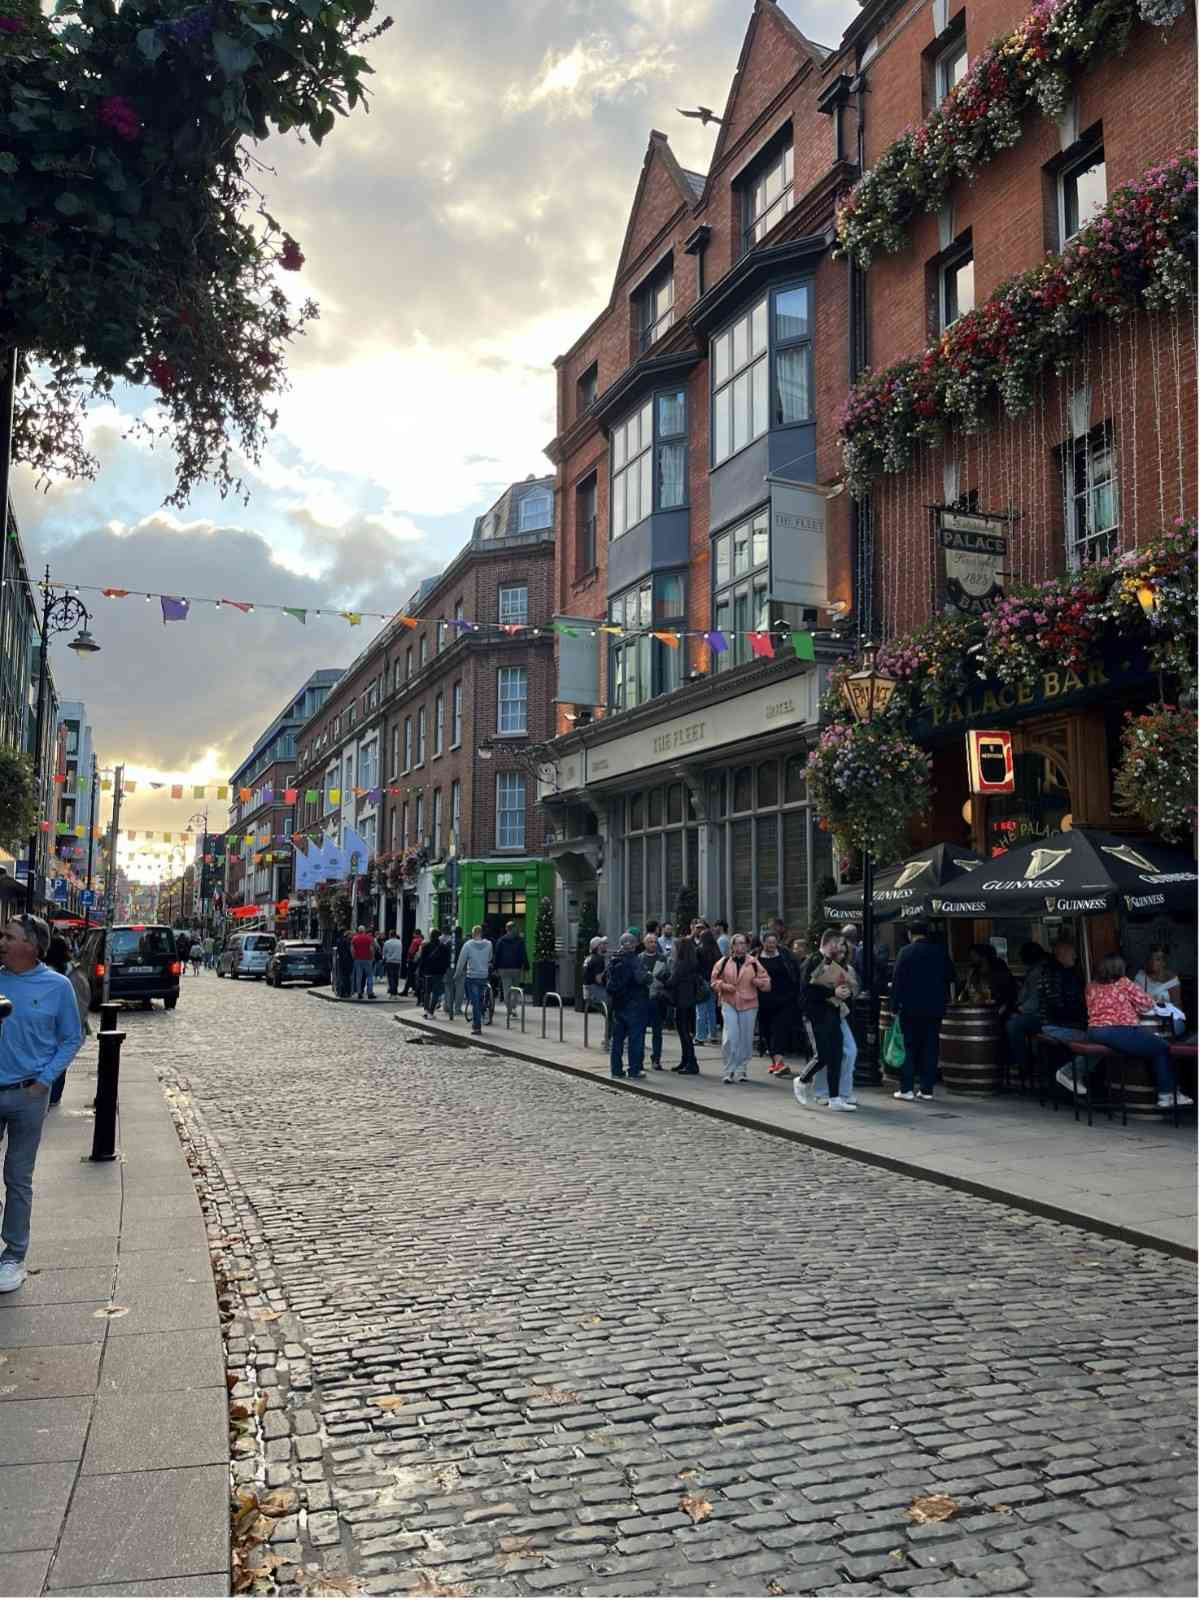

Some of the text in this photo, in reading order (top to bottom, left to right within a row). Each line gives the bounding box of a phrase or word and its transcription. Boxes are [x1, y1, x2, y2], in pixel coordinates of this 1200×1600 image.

[943, 530, 1006, 552] PALACE
[959, 594, 993, 612] BAR
[931, 664, 1110, 727] PALACE BAR
[653, 722, 705, 753] THE FLEET
[54, 879, 62, 889] P
[981, 878, 1065, 891] GUINNESS
[941, 901, 987, 912] GUINNESS
[1056, 898, 1107, 911] GUINNESS
[1131, 893, 1166, 908] GUINNESS
